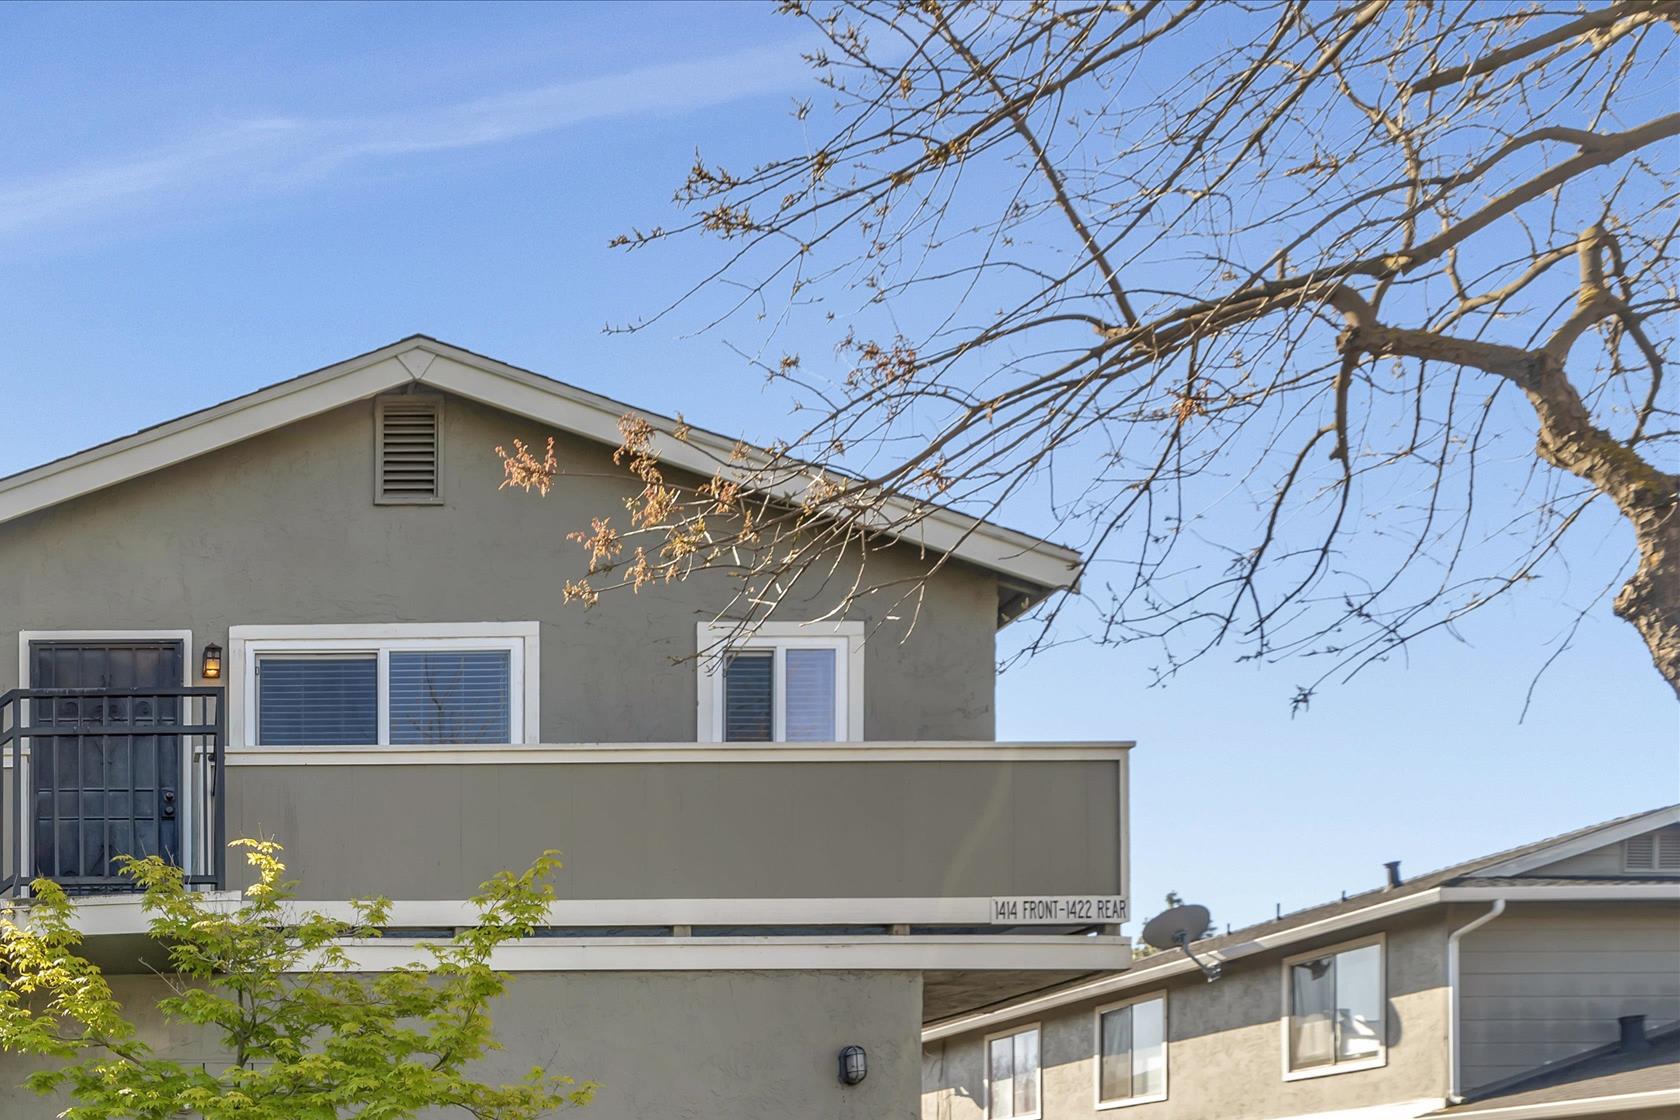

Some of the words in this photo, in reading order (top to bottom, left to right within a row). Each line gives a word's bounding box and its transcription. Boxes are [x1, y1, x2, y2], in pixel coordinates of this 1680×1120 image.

[995, 900, 1017, 920] 1414
[1023, 900, 1092, 919] FRONT-1422
[1097, 899, 1127, 919] REAR
